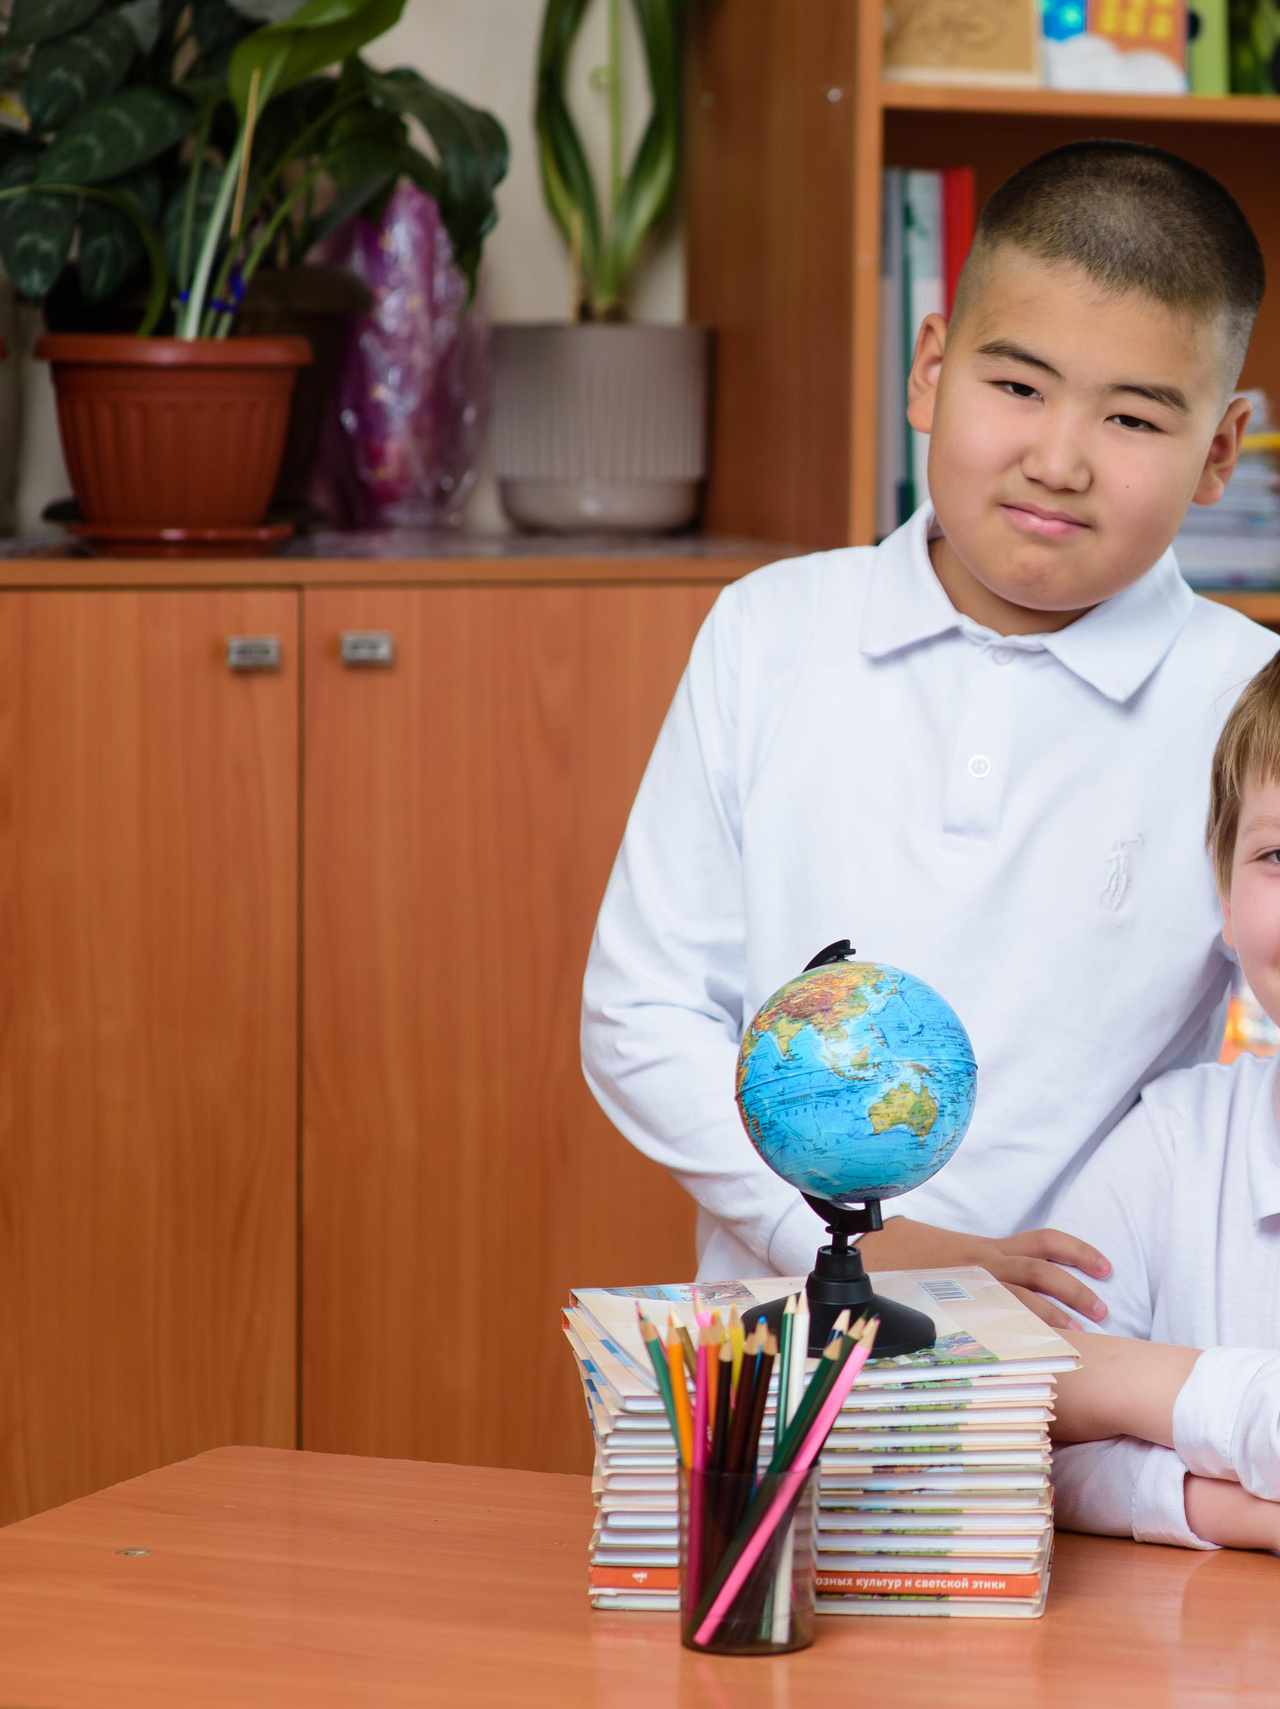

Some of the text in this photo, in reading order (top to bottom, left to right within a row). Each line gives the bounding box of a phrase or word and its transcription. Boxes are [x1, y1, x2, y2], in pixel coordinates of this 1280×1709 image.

[856, 1577, 902, 1591] культур
[904, 1579, 912, 1588] и
[915, 1577, 968, 1590] светской
[972, 1581, 1007, 1590] этики
